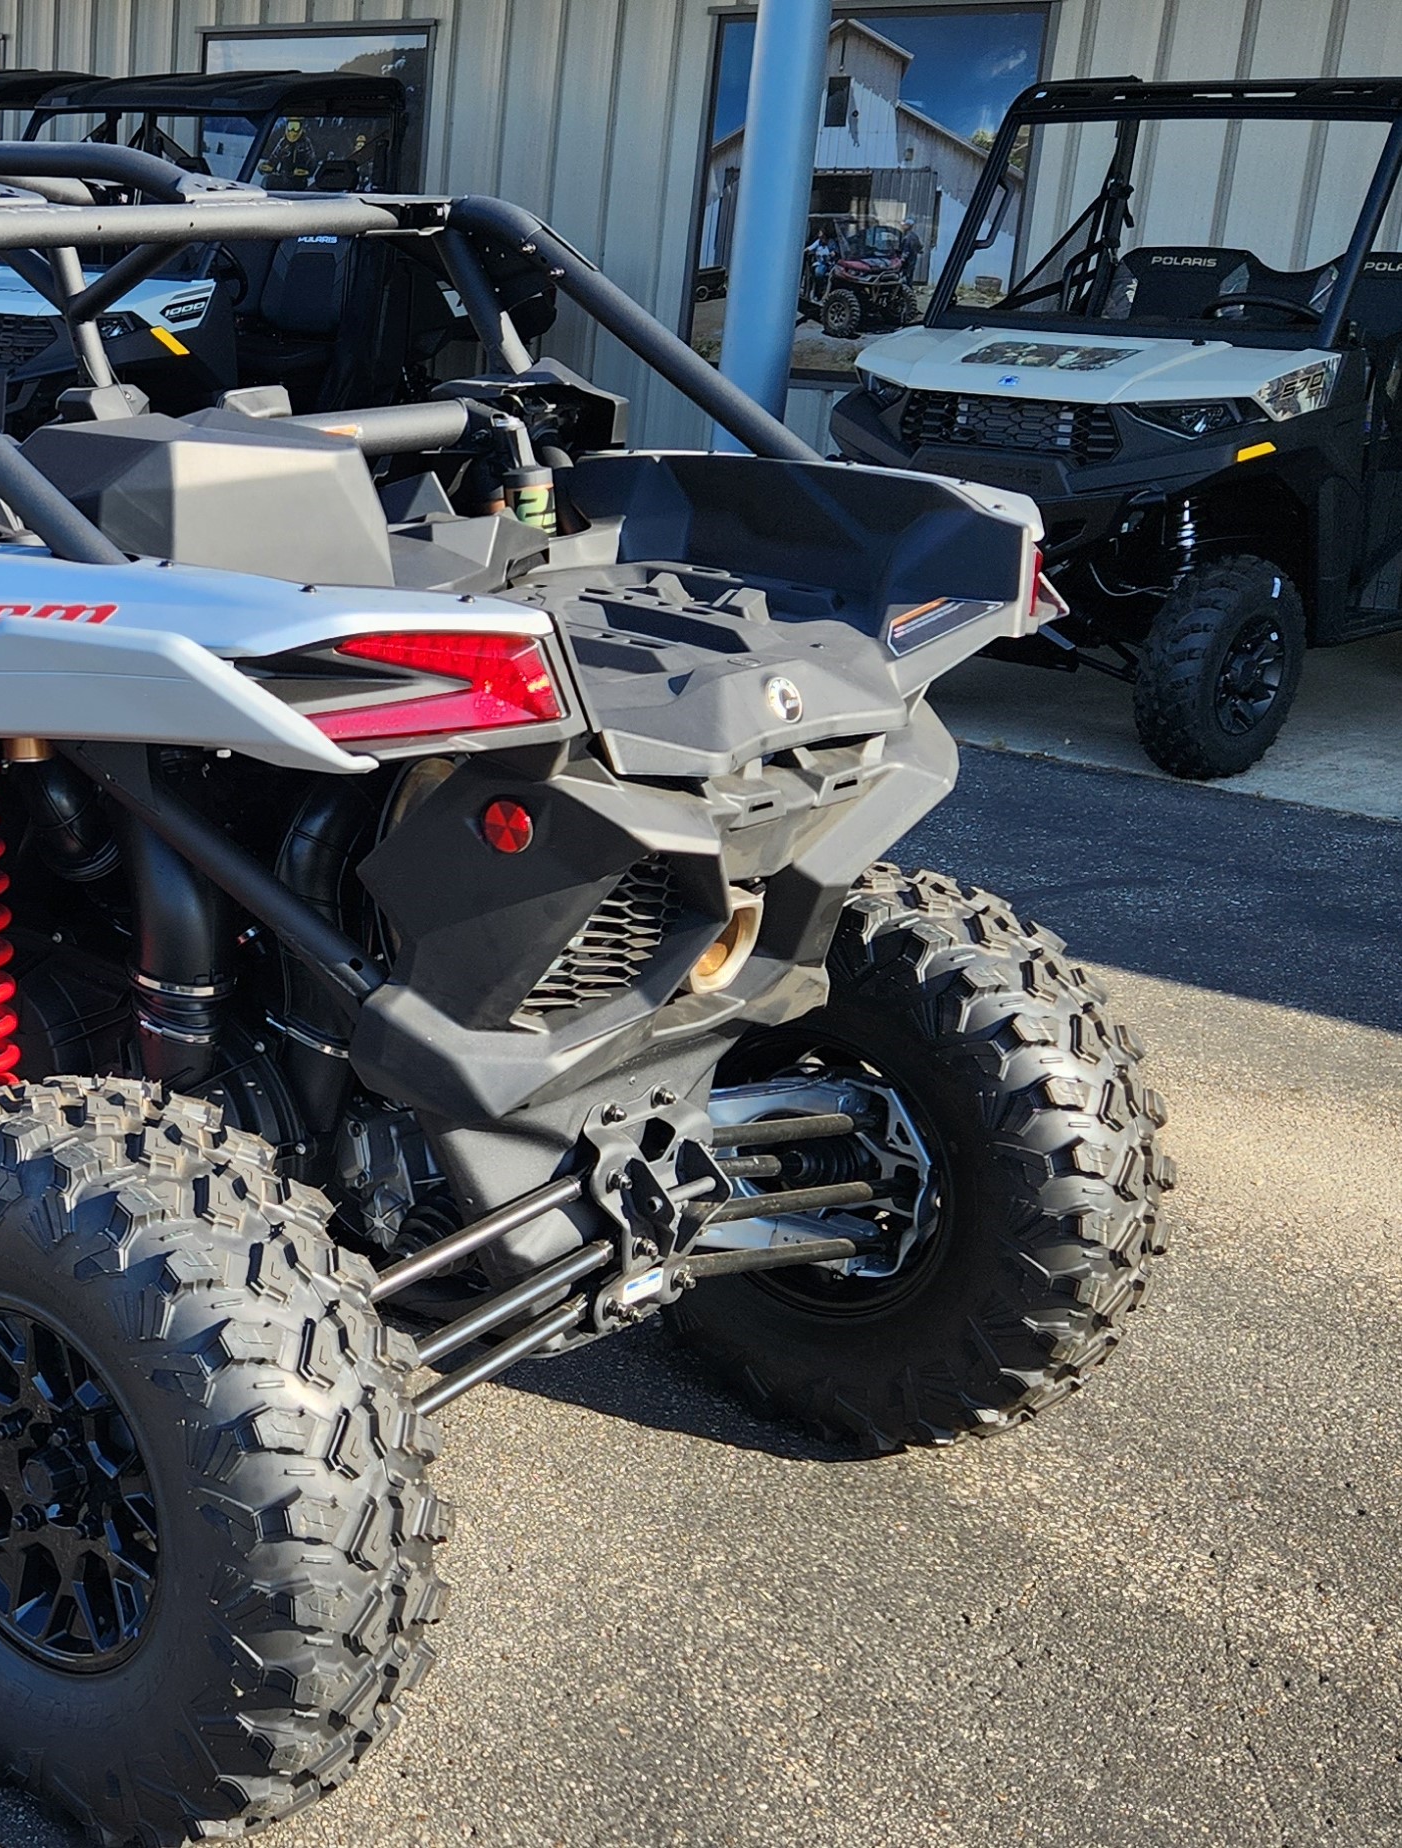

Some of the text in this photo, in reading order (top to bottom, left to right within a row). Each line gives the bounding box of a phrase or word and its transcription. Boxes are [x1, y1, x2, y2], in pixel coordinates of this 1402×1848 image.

[1151, 256, 1218, 267] POLARIS
[164, 301, 206, 317] 1000
[1280, 370, 1325, 399] 570
